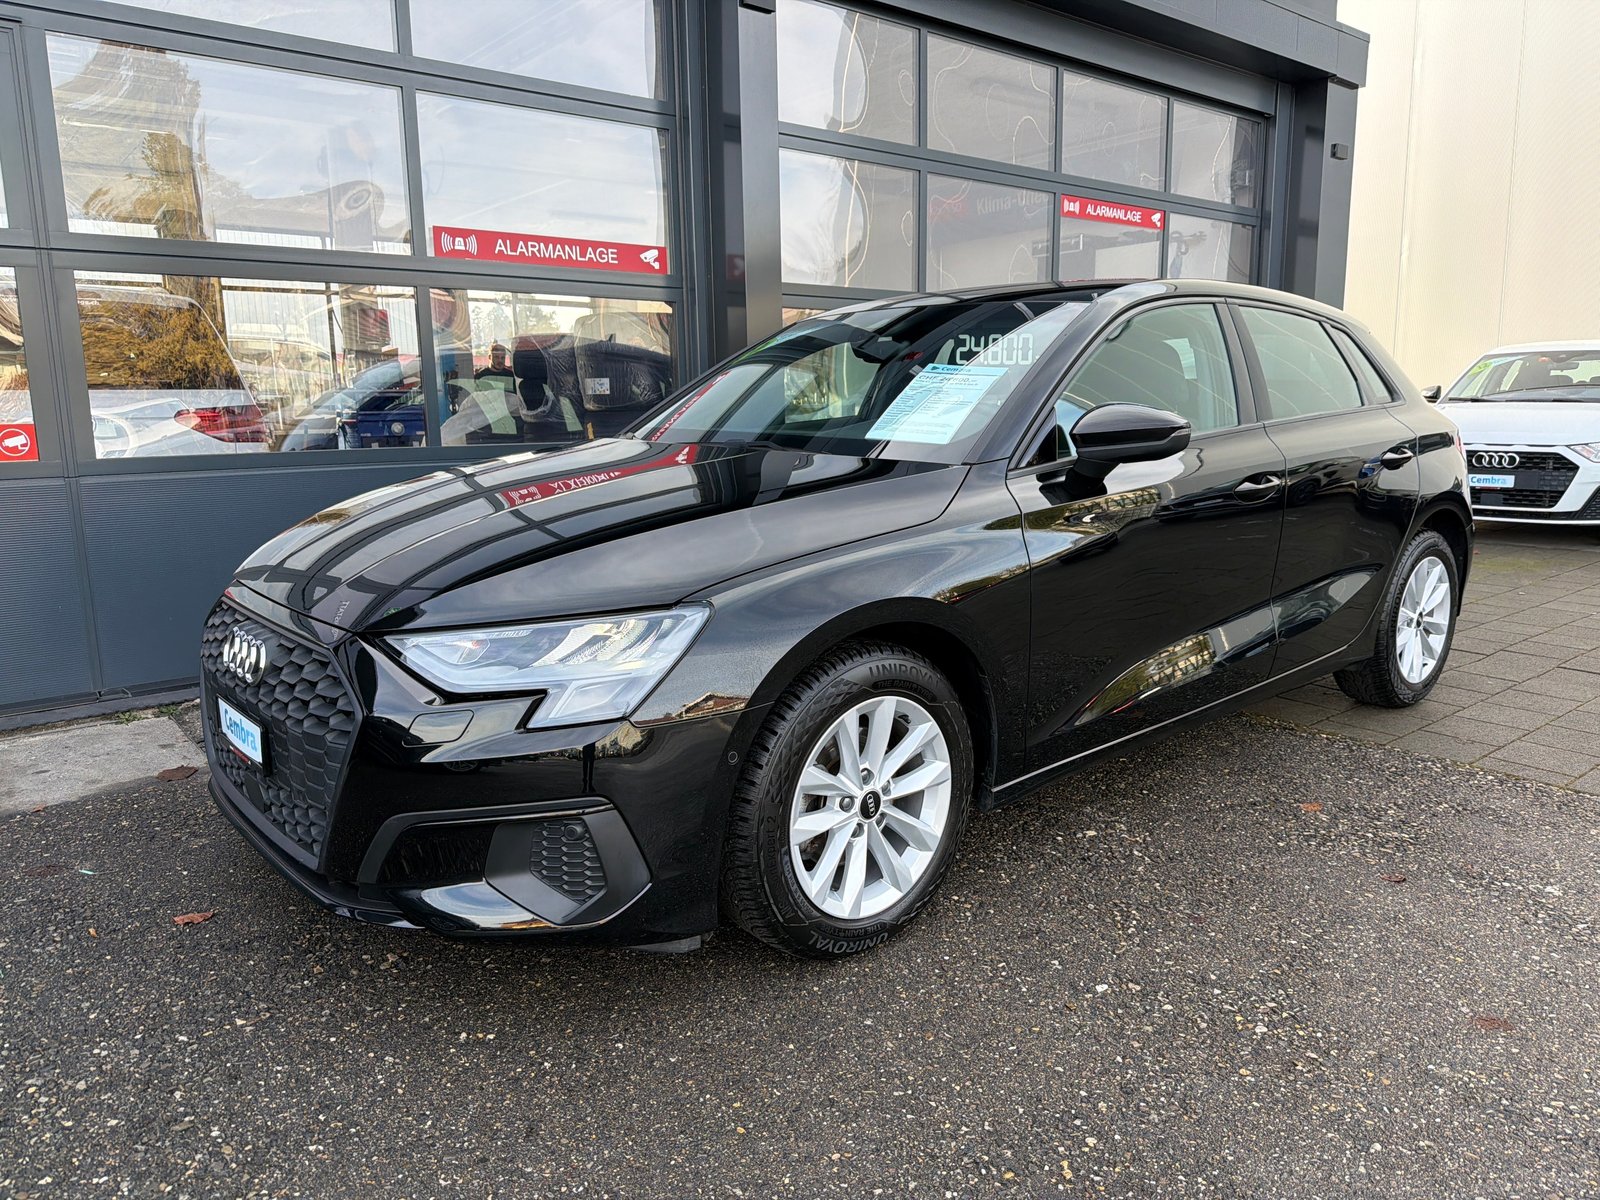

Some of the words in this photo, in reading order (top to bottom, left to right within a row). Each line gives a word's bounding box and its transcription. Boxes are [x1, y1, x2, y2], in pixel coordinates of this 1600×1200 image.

[1085, 203, 1142, 223] ALARMANLAGE
[494, 238, 619, 265] ALARMANLAGE
[955, 333, 1034, 366] 24.800
[1470, 475, 1507, 486] Cembra
[224, 708, 258, 753] Cembra
[808, 930, 889, 954] UNIROYAL
